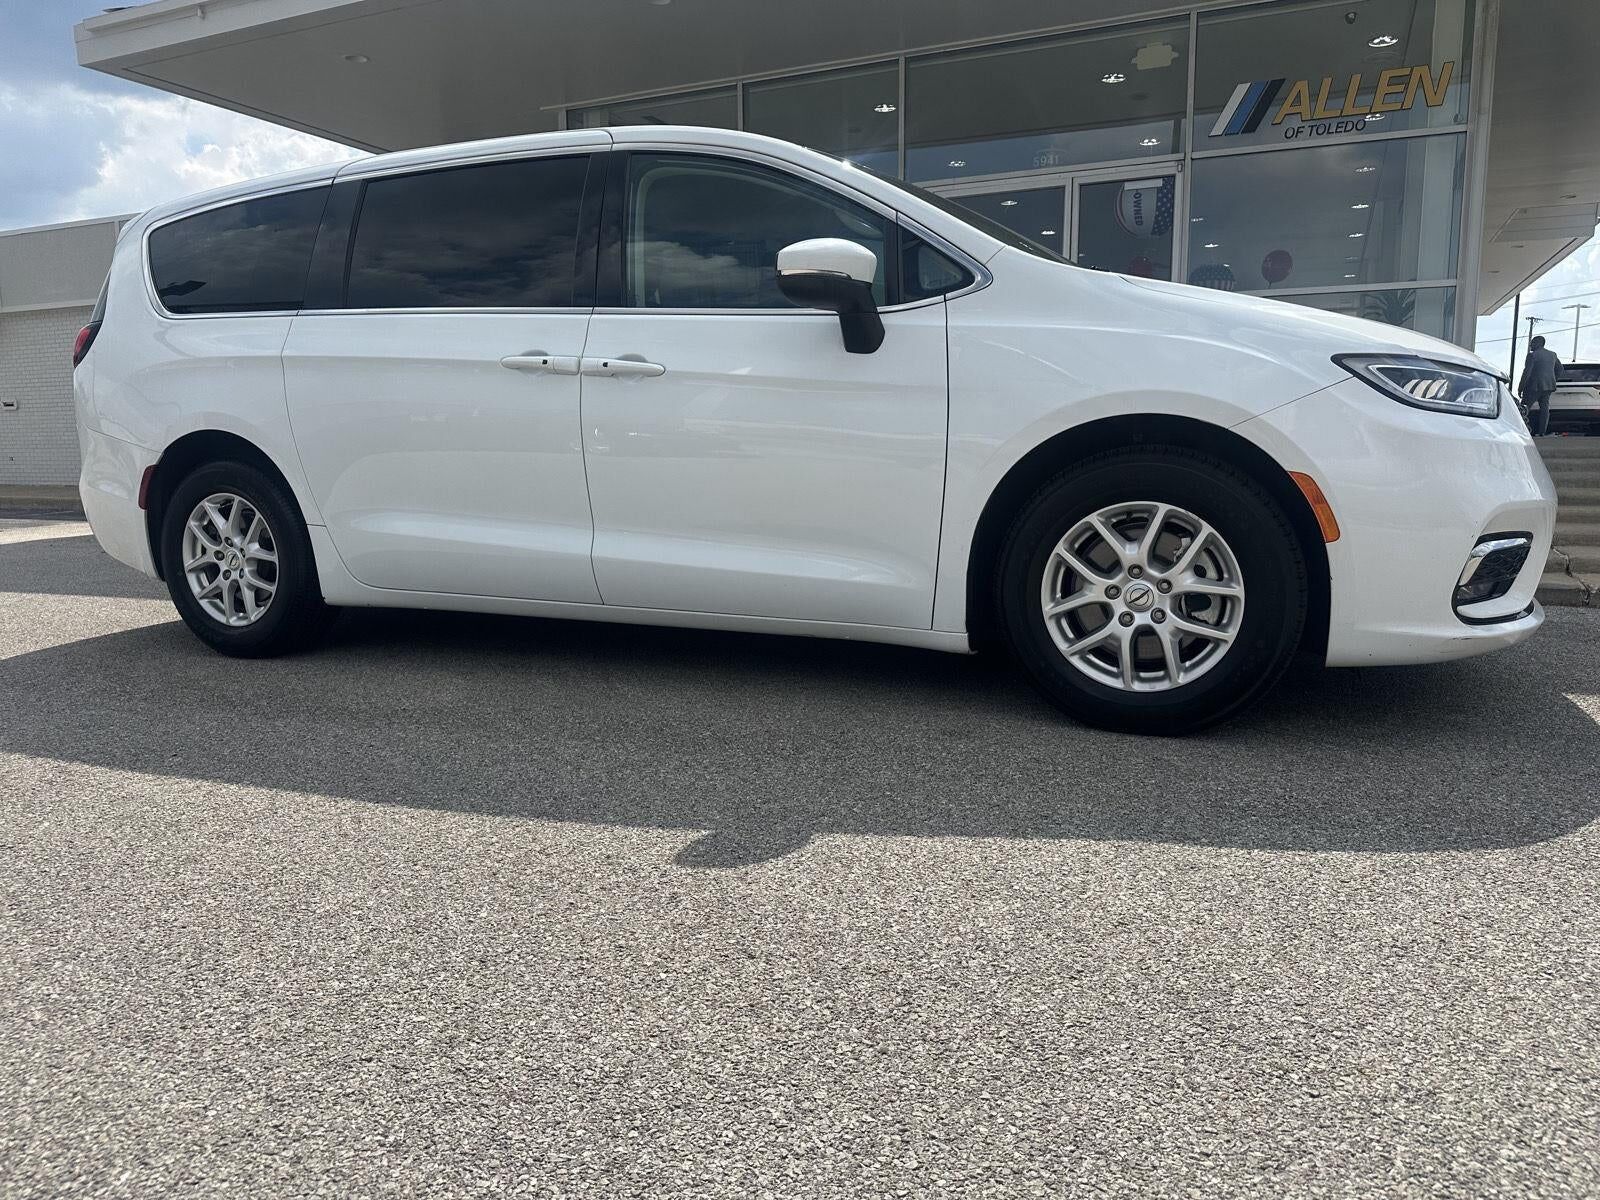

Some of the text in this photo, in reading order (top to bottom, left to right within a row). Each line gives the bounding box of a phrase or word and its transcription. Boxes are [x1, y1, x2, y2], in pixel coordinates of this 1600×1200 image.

[1271, 61, 1455, 126] ALLEN
[1284, 119, 1366, 139] OF TOLEDO
